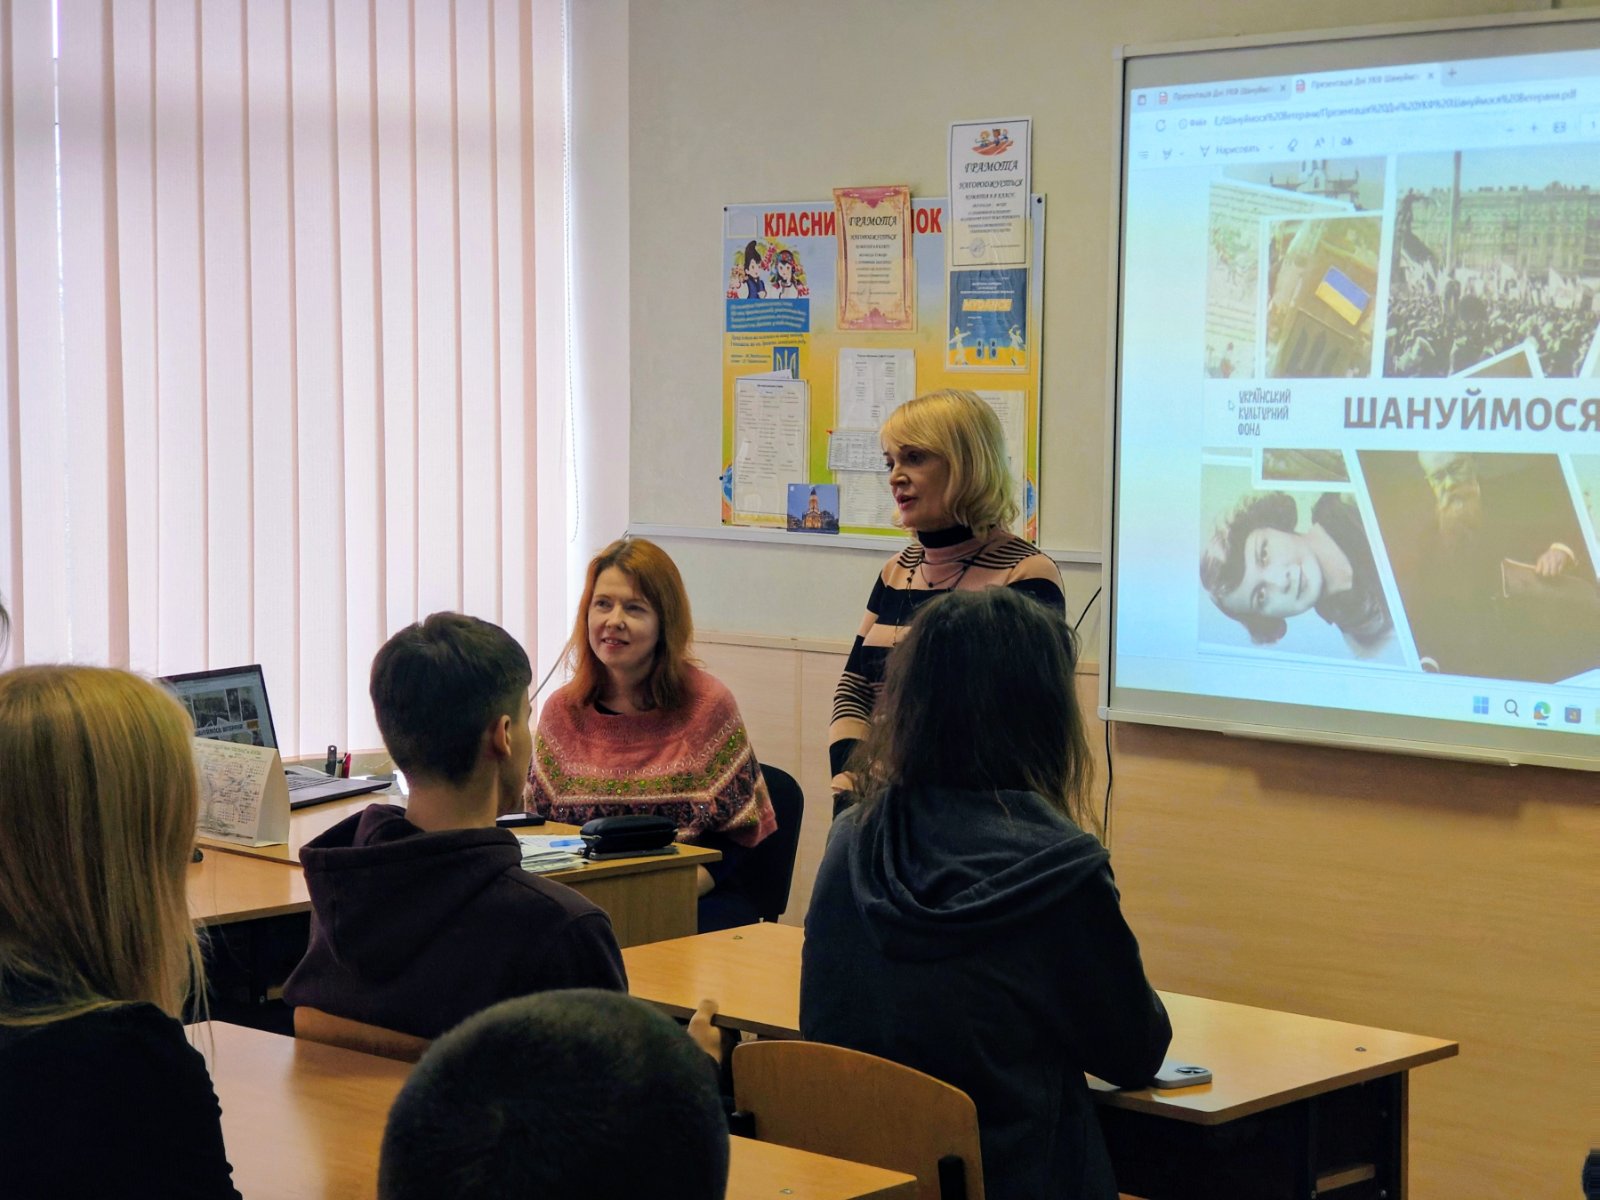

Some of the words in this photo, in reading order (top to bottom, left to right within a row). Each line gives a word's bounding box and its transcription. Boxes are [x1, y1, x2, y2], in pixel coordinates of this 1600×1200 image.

[964, 160, 1019, 173] ГРАМОТА
[764, 210, 836, 238] КЛАСНИ
[849, 216, 897, 227] ГРАМОТА
[1238, 387, 1291, 404] УКРАЇНСЬКИЙ
[1238, 405, 1289, 421] КУЛЬТУРНИЙ
[1343, 387, 1600, 432] ШАНУЙМОСЯ
[1237, 423, 1261, 436] ФОНД
